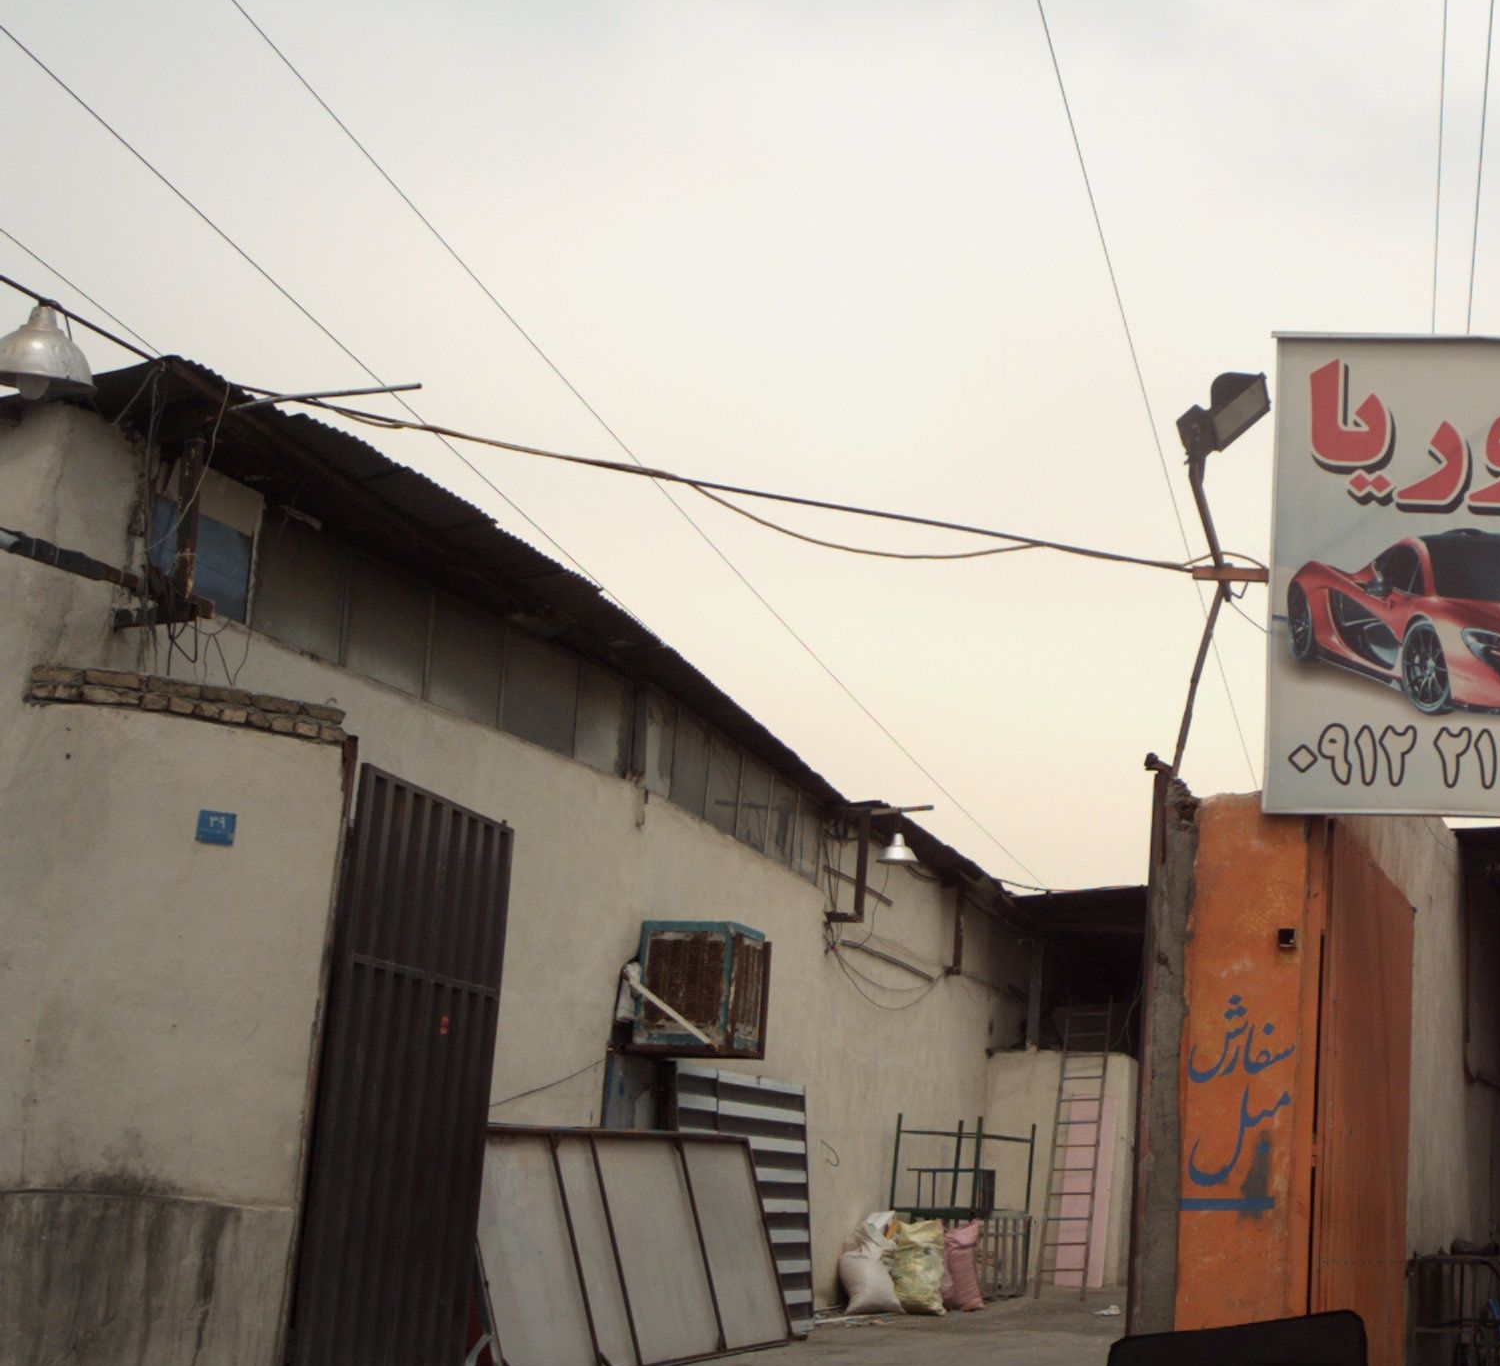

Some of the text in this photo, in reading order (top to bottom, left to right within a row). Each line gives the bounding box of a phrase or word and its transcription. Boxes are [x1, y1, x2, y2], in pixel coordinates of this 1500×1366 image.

[1288, 722, 1418, 786] ۰۹۱۲
[1187, 993, 1296, 1084] سفارش
[1188, 1085, 1291, 1187] مبل
